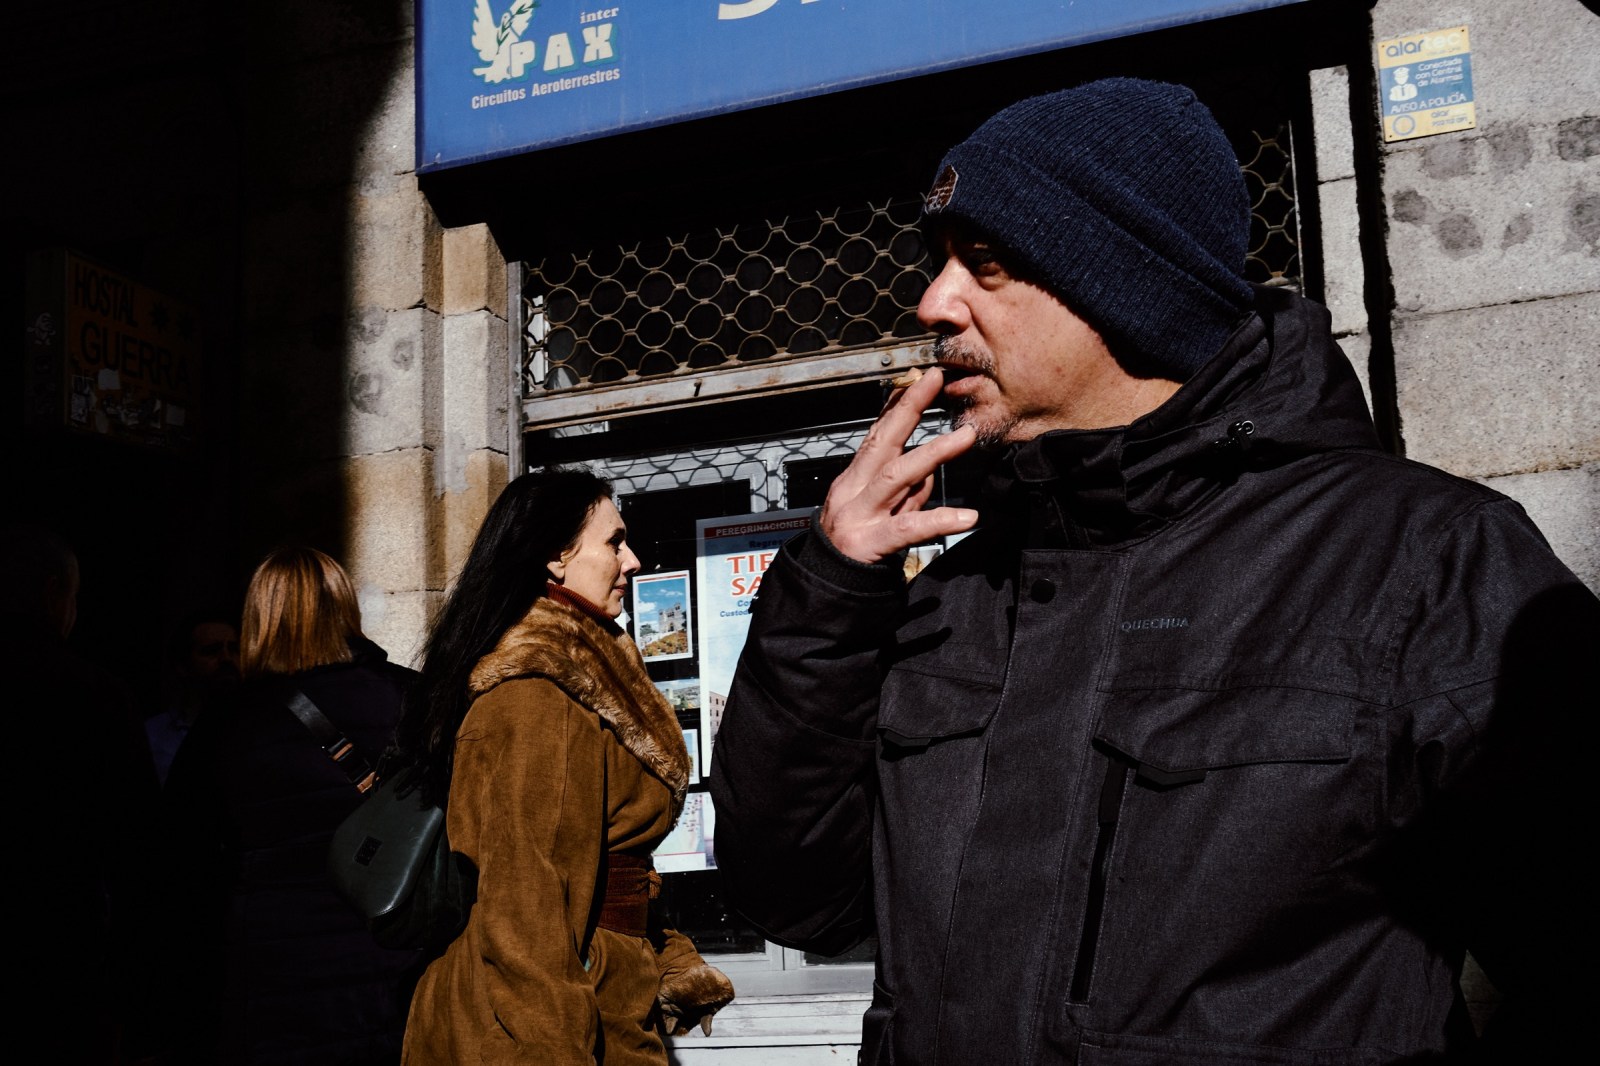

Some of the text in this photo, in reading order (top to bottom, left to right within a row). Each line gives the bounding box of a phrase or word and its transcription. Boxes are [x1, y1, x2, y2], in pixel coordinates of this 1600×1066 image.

[580, 7, 619, 24] inter
[510, 23, 614, 78] PAX
[471, 68, 620, 109] Circuitos Aeroterrestres
[1390, 101, 1418, 114] AVISO
[1419, 100, 1428, 109] A
[72, 262, 137, 328] HOSTAL
[80, 319, 189, 392] GUERRA
[715, 519, 805, 536] PEREGRINACIONES
[1121, 617, 1189, 632] QUECHUA
